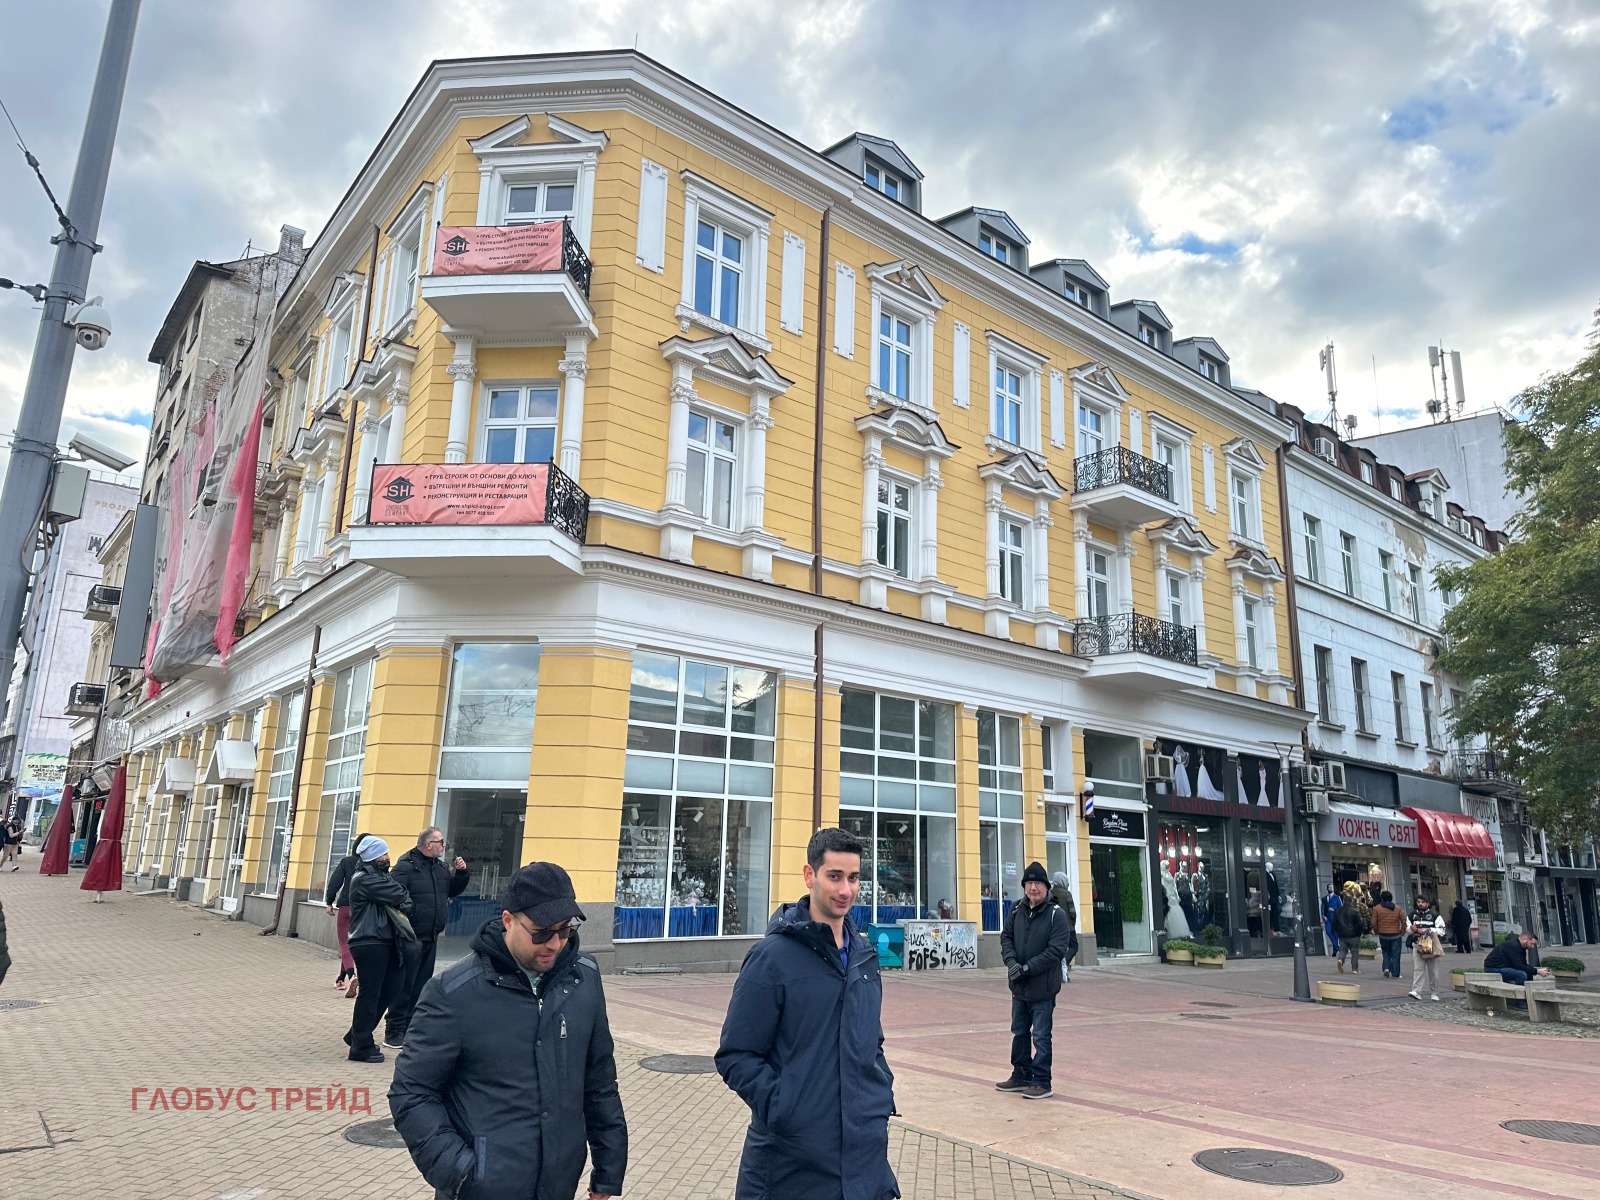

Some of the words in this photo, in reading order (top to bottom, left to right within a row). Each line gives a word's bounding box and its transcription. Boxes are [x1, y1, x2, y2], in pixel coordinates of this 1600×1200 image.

[447, 242, 466, 251] SH
[388, 485, 409, 496] SH
[1338, 818, 1380, 840] КОЖЕН
[1388, 824, 1416, 844] СВЯТ
